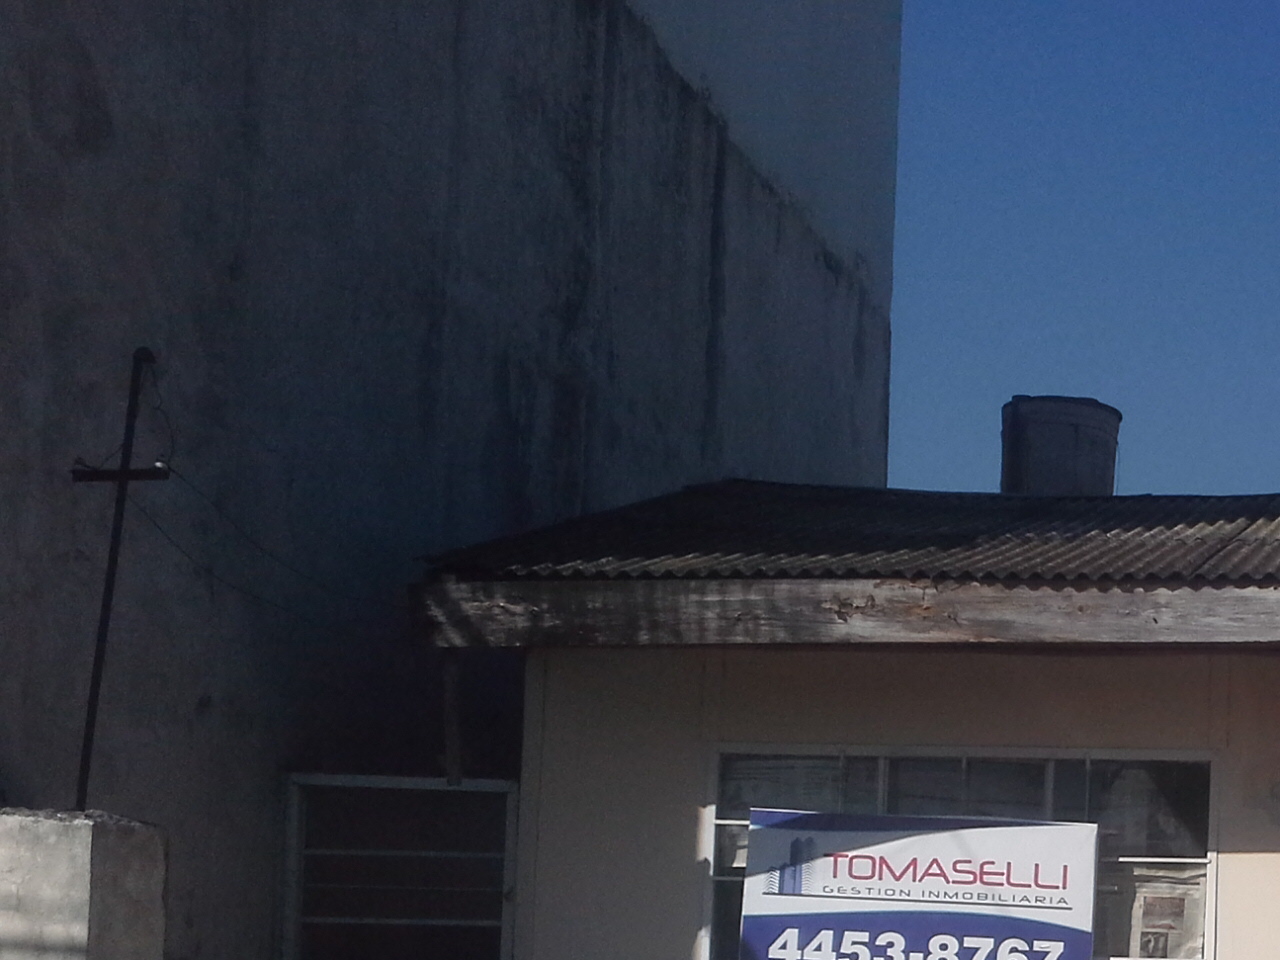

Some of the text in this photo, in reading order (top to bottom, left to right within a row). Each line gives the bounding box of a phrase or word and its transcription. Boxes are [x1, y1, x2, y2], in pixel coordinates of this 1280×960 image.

[823, 852, 1069, 890] TOMASELLI
[822, 885, 1069, 905] GESTION INMOBILIARIA
